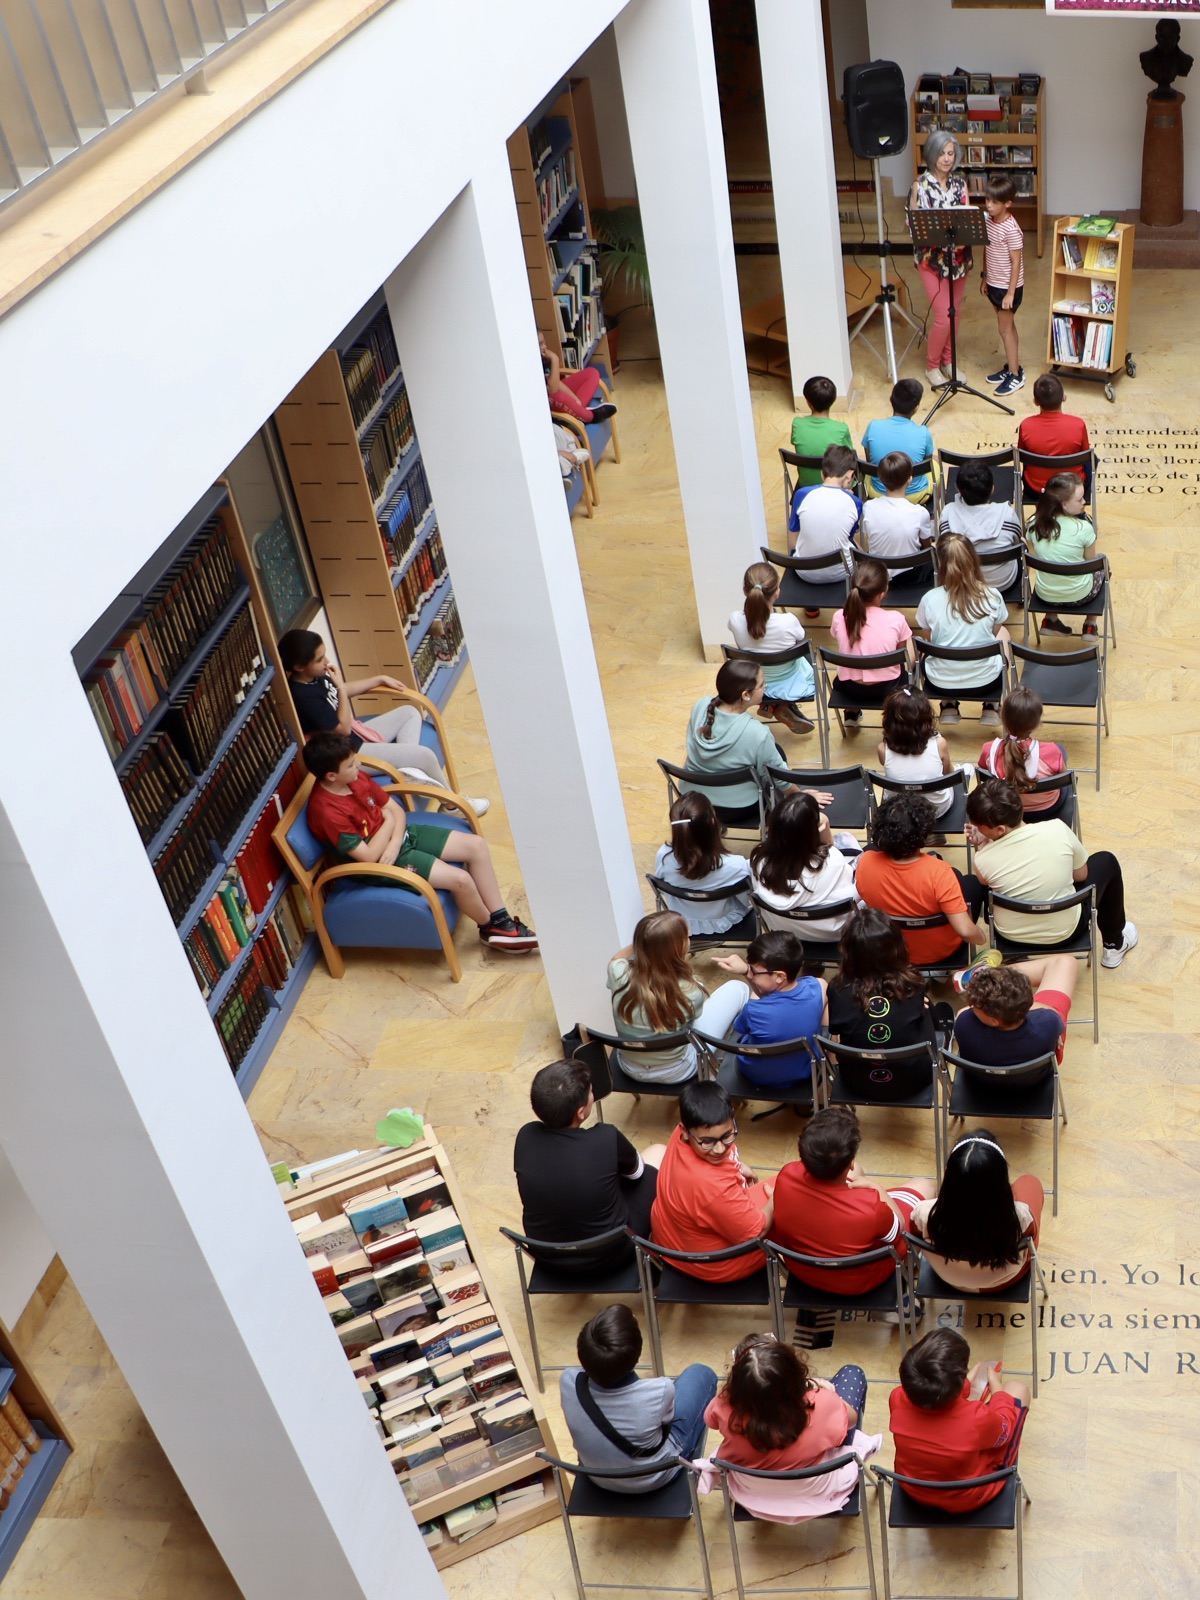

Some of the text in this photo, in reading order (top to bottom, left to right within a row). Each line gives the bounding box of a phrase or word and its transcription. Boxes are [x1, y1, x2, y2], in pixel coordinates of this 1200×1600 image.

[1175, 441, 1198, 449] mí
[1101, 455, 1151, 464] culto
[1126, 472, 1159, 480] voz
[1166, 471, 1189, 480] de
[1094, 485, 1164, 495] ERICO
[1120, 1263, 1160, 1286] Yo
[937, 1305, 964, 1328] él
[975, 1311, 1026, 1329] me
[1037, 1305, 1114, 1329] lleva
[1040, 1351, 1151, 1382] JUAN
